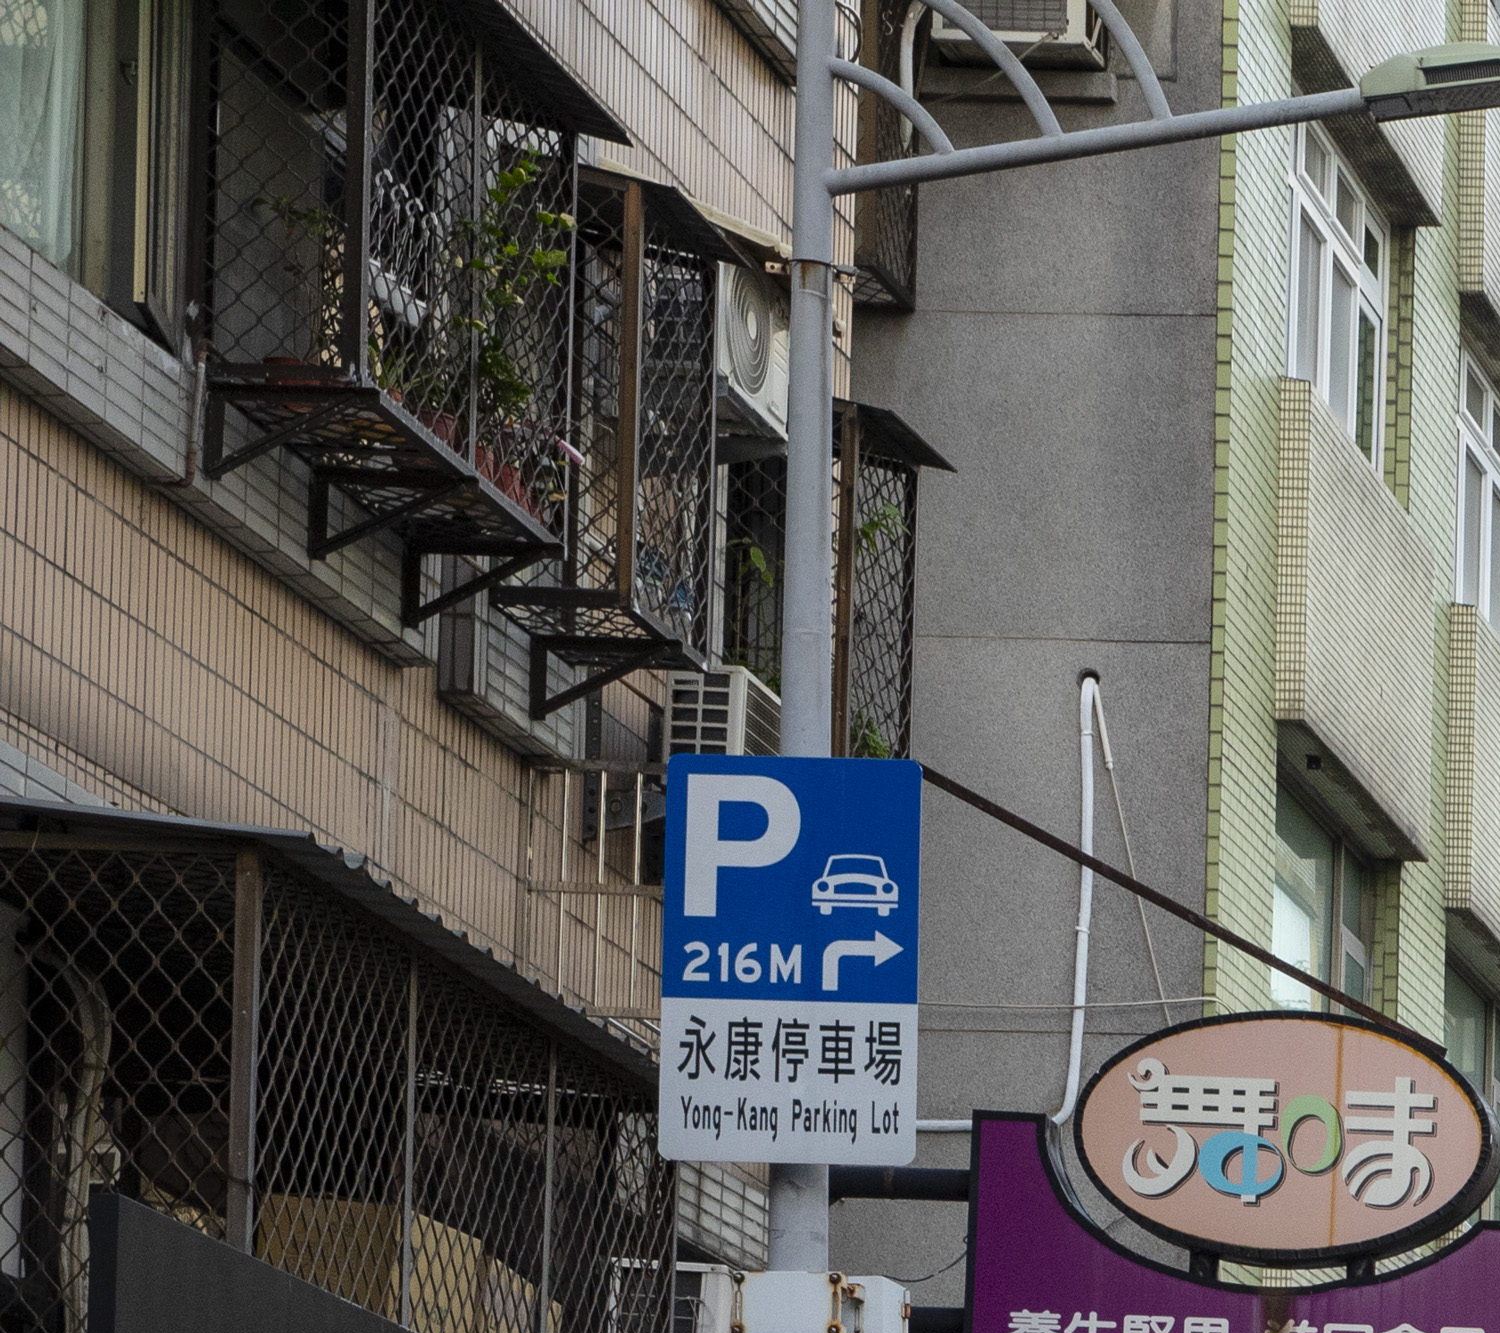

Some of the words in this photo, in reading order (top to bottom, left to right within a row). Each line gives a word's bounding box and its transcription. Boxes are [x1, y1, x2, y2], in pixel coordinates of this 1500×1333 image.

[683, 774, 801, 916] P
[682, 941, 803, 985] 216M
[677, 1016, 902, 1086] 永康停車場
[681, 1095, 779, 1143] Yong-Kang
[791, 1097, 858, 1140] Parking
[870, 1097, 900, 1134] Lot
